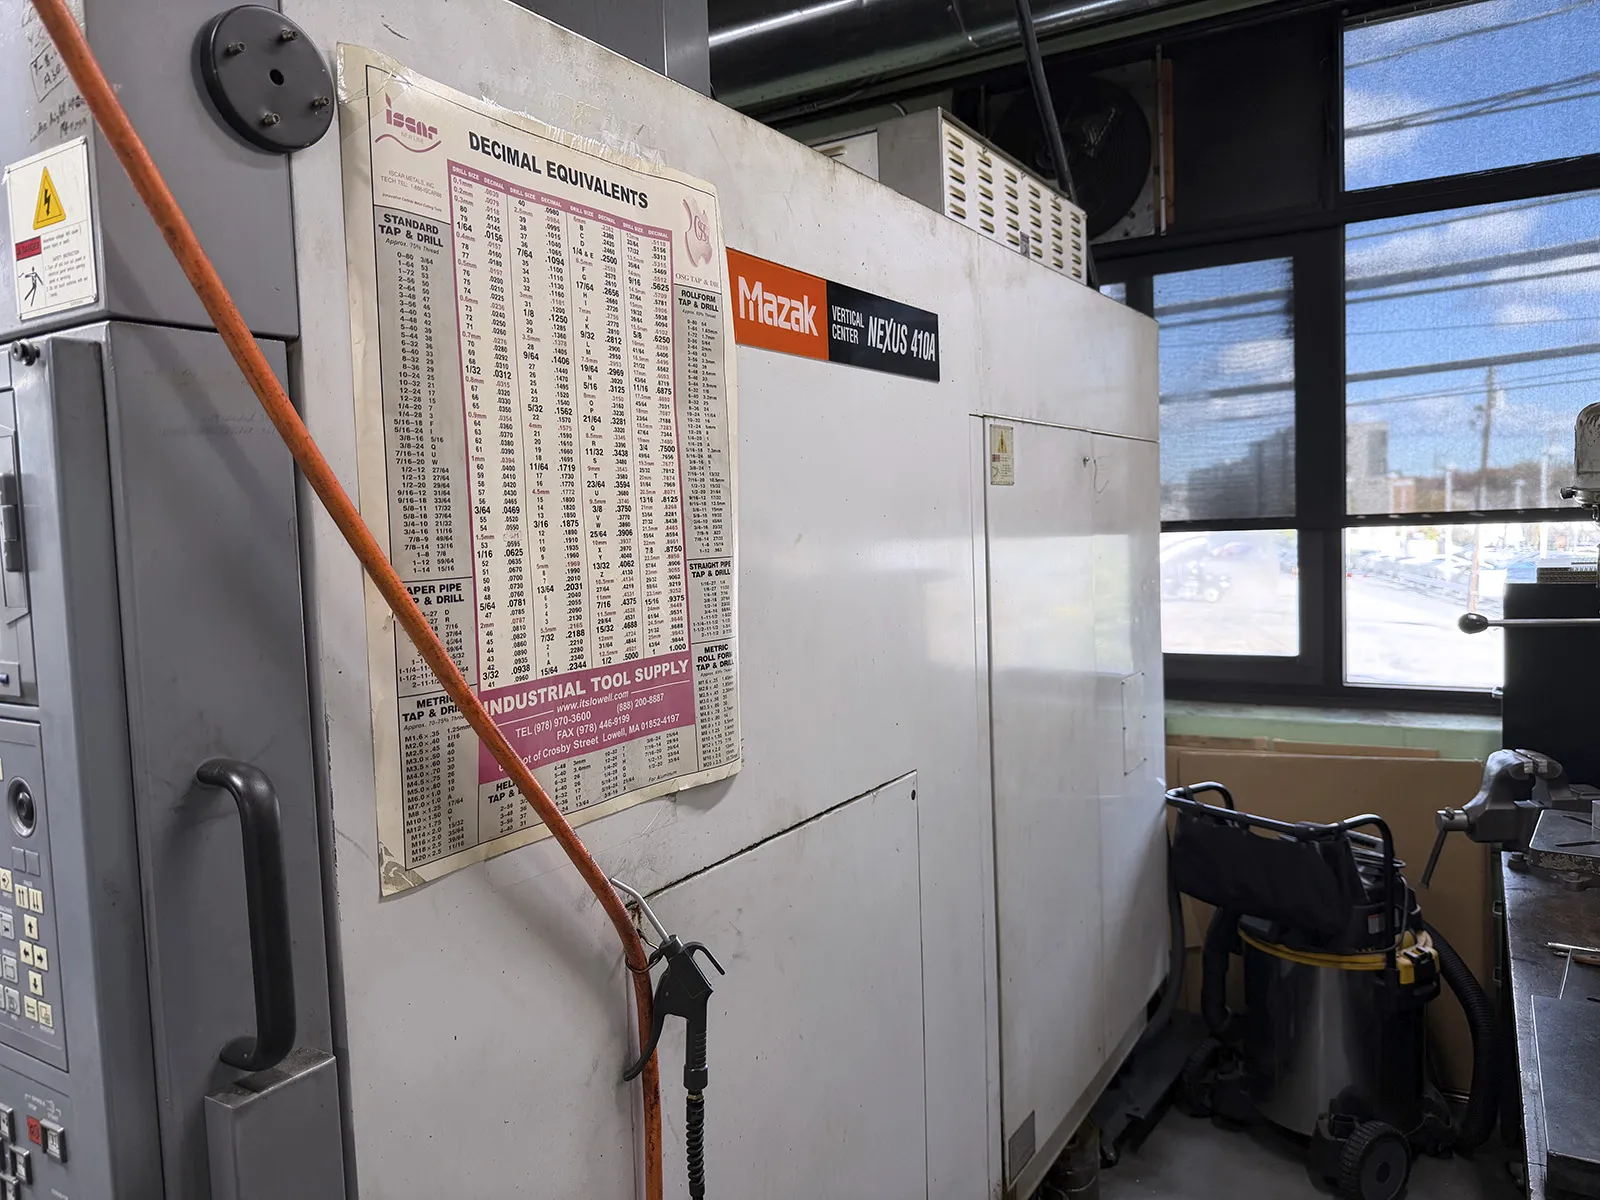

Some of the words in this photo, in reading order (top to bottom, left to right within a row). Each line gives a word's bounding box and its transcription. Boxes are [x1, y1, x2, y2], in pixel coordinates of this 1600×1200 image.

[452, 166, 467, 177] DRILL
[468, 171, 480, 181] SIZE
[468, 131, 542, 174] DECIMAL
[546, 160, 649, 209] EQUIVALENTS
[483, 177, 505, 190] DECIMAL
[509, 187, 524, 197] DRILL
[524, 191, 537, 200] SIZE
[569, 205, 583, 215] DRILL
[383, 213, 439, 235] STANDARD
[378, 224, 401, 236] TAP
[405, 230, 413, 240] &
[416, 232, 444, 248] DRILL
[456, 221, 473, 232] 1/64
[484, 230, 504, 243] .0156
[385, 237, 408, 248] Approx.
[572, 246, 583, 256] 1/4
[600, 255, 618, 265] .2500
[628, 276, 641, 286] 9/16
[650, 282, 670, 292] .5625
[675, 272, 690, 281] OSG
[690, 275, 702, 284] TAP
[681, 289, 716, 303] ROLLFORM
[678, 297, 692, 307] TAP
[693, 301, 699, 309] &
[700, 301, 719, 312] DRILL
[738, 275, 819, 337] Mazak
[399, 308, 417, 316] 4-40
[523, 308, 535, 318] 1/8
[548, 314, 568, 324] .1250
[831, 305, 865, 329] VERTICAL
[632, 331, 643, 340] 5/8
[652, 335, 671, 344] .6250
[831, 323, 859, 345] CENTER
[867, 315, 909, 355] NEXUS
[910, 328, 936, 362] 410A
[398, 371, 420, 379] 10-24
[465, 365, 482, 375] 1/32
[493, 369, 512, 380] .0312
[398, 403, 422, 411] 1/4-20
[527, 404, 544, 413] 5/32
[554, 407, 573, 416] .1562
[529, 463, 549, 471] 11/64
[557, 464, 576, 472] .1719
[474, 506, 491, 515] 3/64
[501, 506, 521, 515] .0469
[592, 505, 603, 513] 3/8
[615, 505, 632, 513] .3750
[533, 520, 549, 529] 3/16
[560, 519, 580, 528] .1875
[476, 550, 493, 559] 1/16
[503, 548, 524, 557] .0625
[689, 561, 719, 571] STRAIGHT
[720, 560, 731, 568] PIPE
[691, 570, 706, 578] TAP
[714, 568, 731, 576] DRILL
[405, 584, 436, 595] APER
[439, 583, 463, 593] PIPE
[424, 596, 432, 606] &
[436, 593, 465, 605] DRILL
[596, 600, 611, 609] 7/16
[621, 598, 637, 607] .4375
[669, 643, 687, 651] 1.000
[704, 643, 729, 654] METRIC
[601, 657, 612, 665] 1/2
[623, 652, 639, 661] .5000
[697, 652, 716, 663] ROLL
[482, 670, 500, 681] 3/32
[511, 665, 531, 675] .0938
[540, 666, 559, 676] 15/64
[567, 661, 587, 671] .2344
[696, 662, 711, 672] TAP
[712, 661, 718, 669] &
[483, 680, 587, 717] INDUSTRIAL
[590, 671, 631, 692] TOOL
[635, 659, 689, 682] SUPPLY
[556, 690, 629, 713] www.itslowell.com
[402, 710, 425, 722] TAP
[429, 708, 437, 718] &
[440, 704, 461, 716] DRI
[515, 726, 533, 738] TEL
[533, 719, 553, 736] (978)
[553, 711, 592, 727] 970-3600
[556, 727, 575, 740] FAX
[576, 722, 597, 737] (978)
[599, 713, 631, 730] 446-9199
[533, 751, 542, 761] of
[542, 743, 571, 758] Crosby
[573, 735, 599, 749] Street
[602, 728, 628, 742] Lowell,
[628, 723, 640, 734] MA
[641, 713, 680, 730] 01852-4197
[407, 786, 425, 796] M5.0
[488, 792, 506, 804] TAP
[508, 789, 515, 798] &
